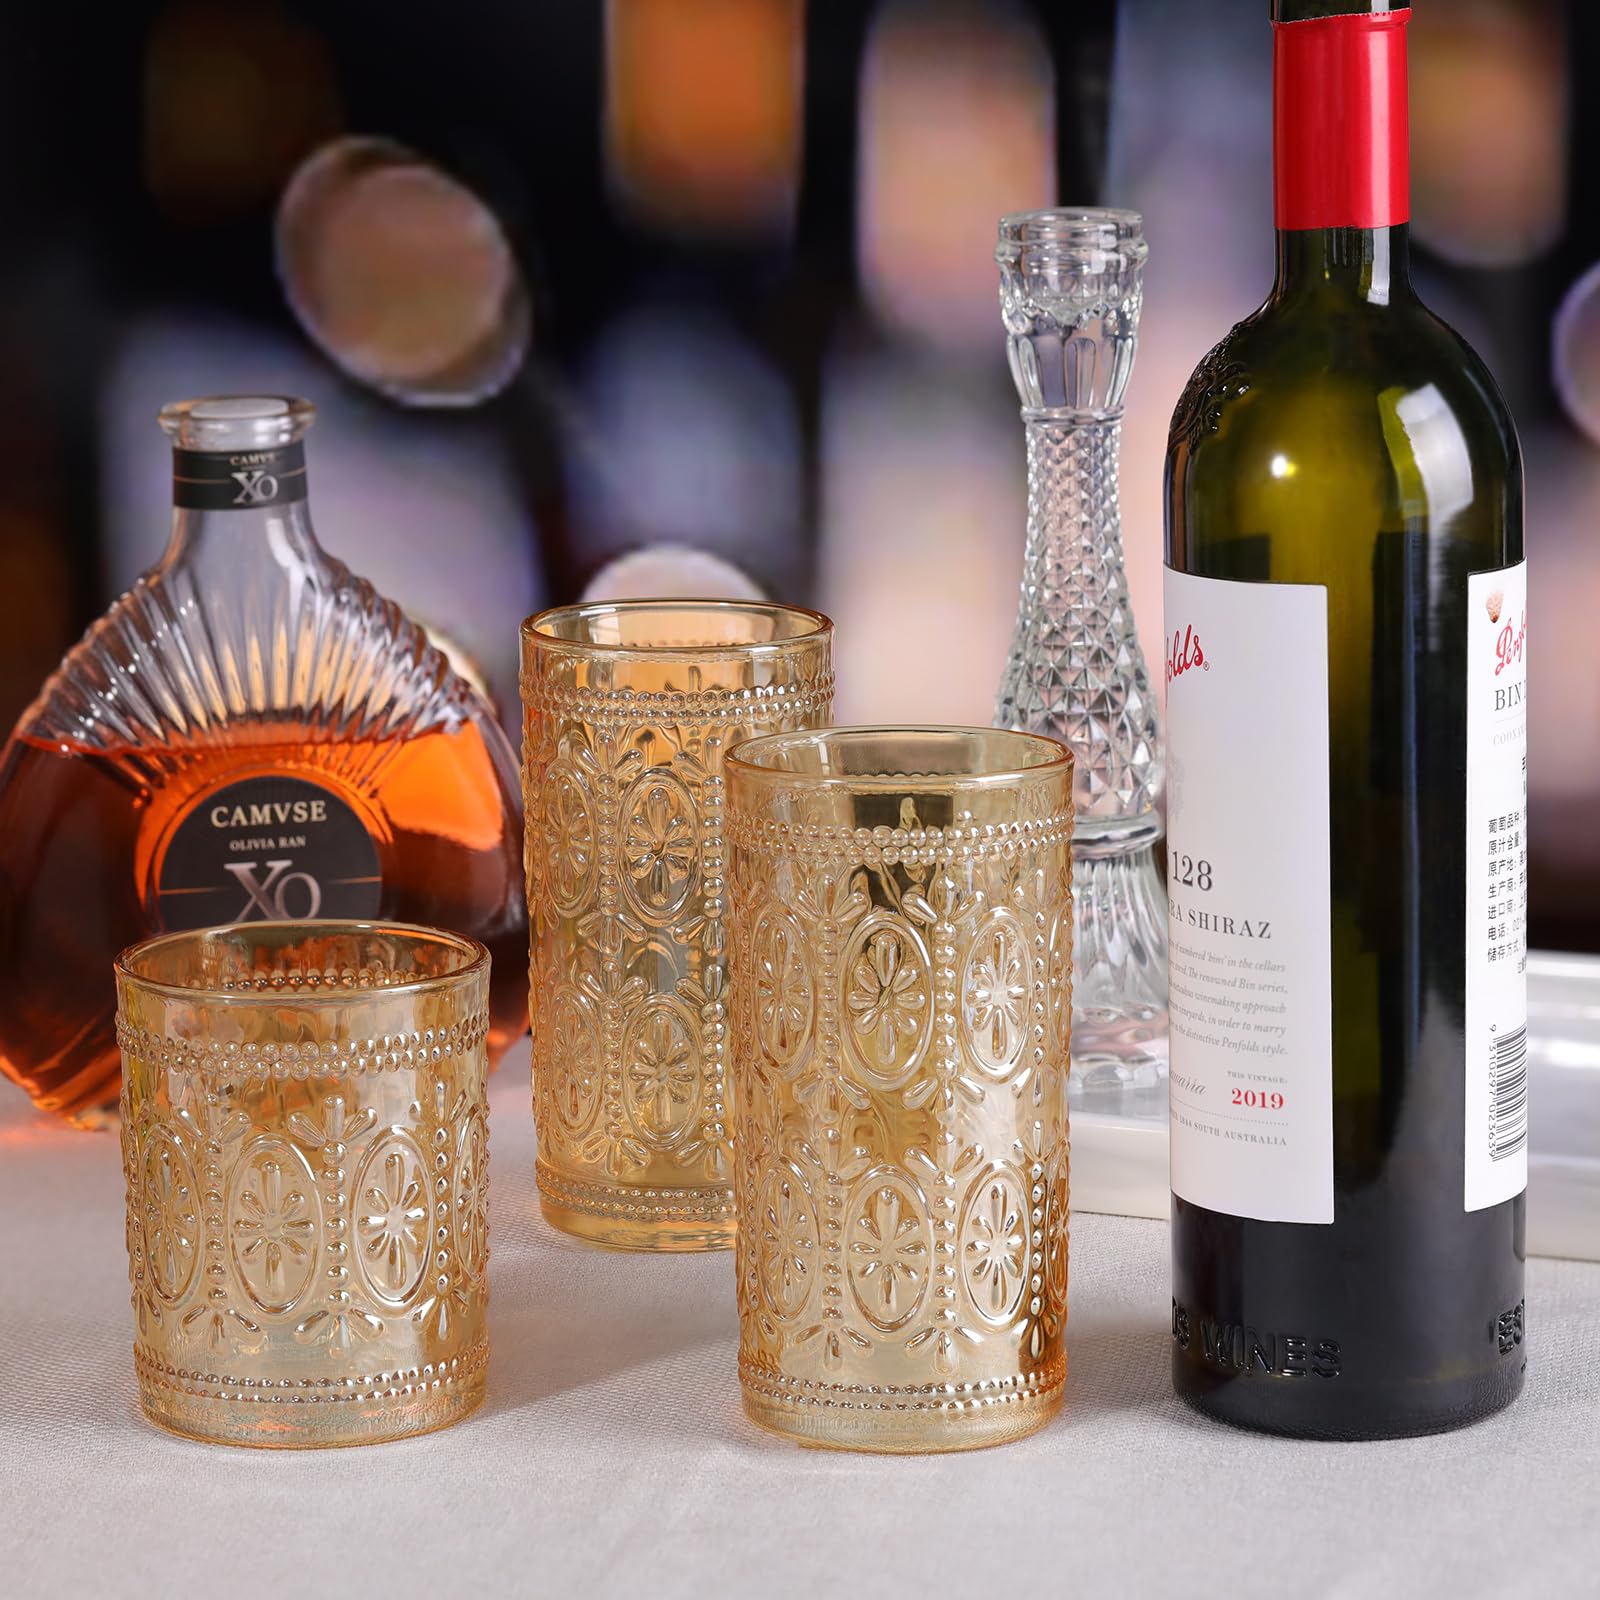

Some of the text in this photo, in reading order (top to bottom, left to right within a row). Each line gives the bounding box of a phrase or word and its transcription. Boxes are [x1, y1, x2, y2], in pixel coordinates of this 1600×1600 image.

[231, 470, 278, 504] XO
[210, 800, 327, 828] CAMVSE
[229, 837, 275, 851] OLIVIA
[1172, 851, 1212, 892] 128
[224, 859, 322, 921] XO
[1188, 909, 1272, 939] SHIRAZ
[1228, 956, 1237, 967] in
[1239, 957, 1253, 969] the
[1255, 960, 1286, 973] cellars
[1239, 978, 1256, 991] Bin
[1242, 1001, 1287, 1015] approach
[1217, 1017, 1241, 1029] order
[1242, 1021, 1251, 1031] to
[1253, 1025, 1287, 1038] marry
[1221, 1037, 1259, 1053] Penfolds
[1262, 1042, 1288, 1058] style.
[1231, 1087, 1284, 1110] 2019
[1193, 1123, 1220, 1137] SOUTH
[1223, 1130, 1287, 1146] AUSTRALIA
[1200, 1318, 1343, 1378] WINES
